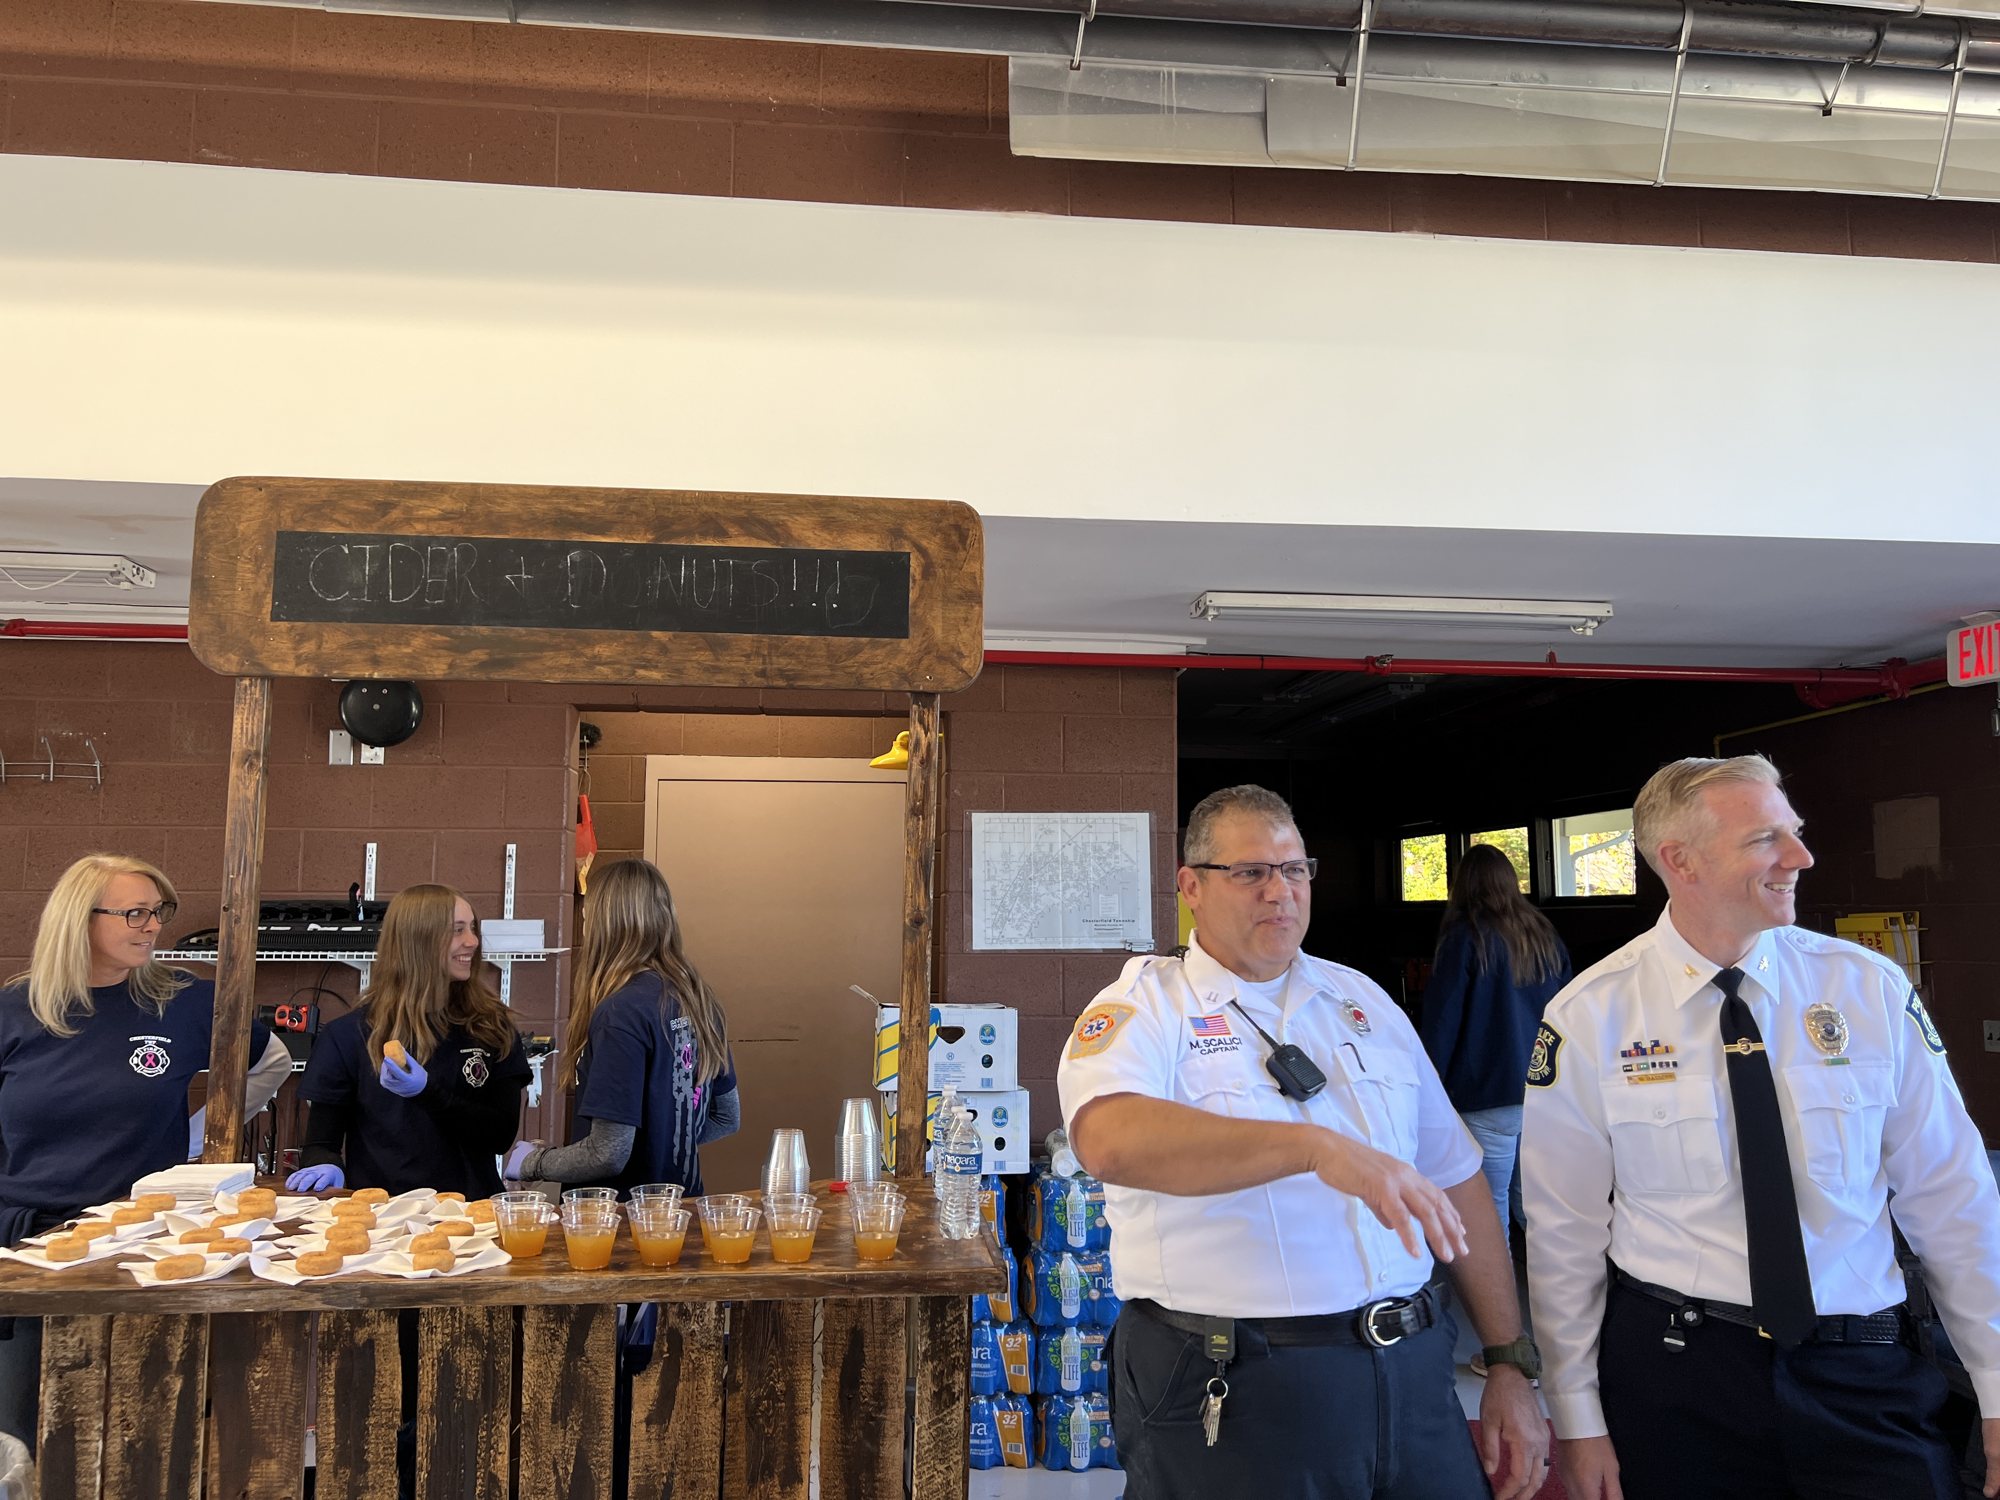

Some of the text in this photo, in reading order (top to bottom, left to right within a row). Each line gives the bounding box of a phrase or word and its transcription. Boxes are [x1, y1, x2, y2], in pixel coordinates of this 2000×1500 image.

[309, 542, 489, 605] CIDER
[1874, 931, 1884, 953] SAF
[669, 1016, 689, 1031] CHE
[1189, 1040, 1203, 1050] M.
[1200, 1046, 1239, 1055] CAPTAIN
[1070, 1221, 1085, 1238] LIFE
[1095, 1276, 1114, 1289] nia
[1005, 1337, 1022, 1348] 32
[1063, 1364, 1079, 1381] LIFE
[1002, 1414, 1018, 1425] 32
[1073, 1441, 1089, 1458] LIFE
